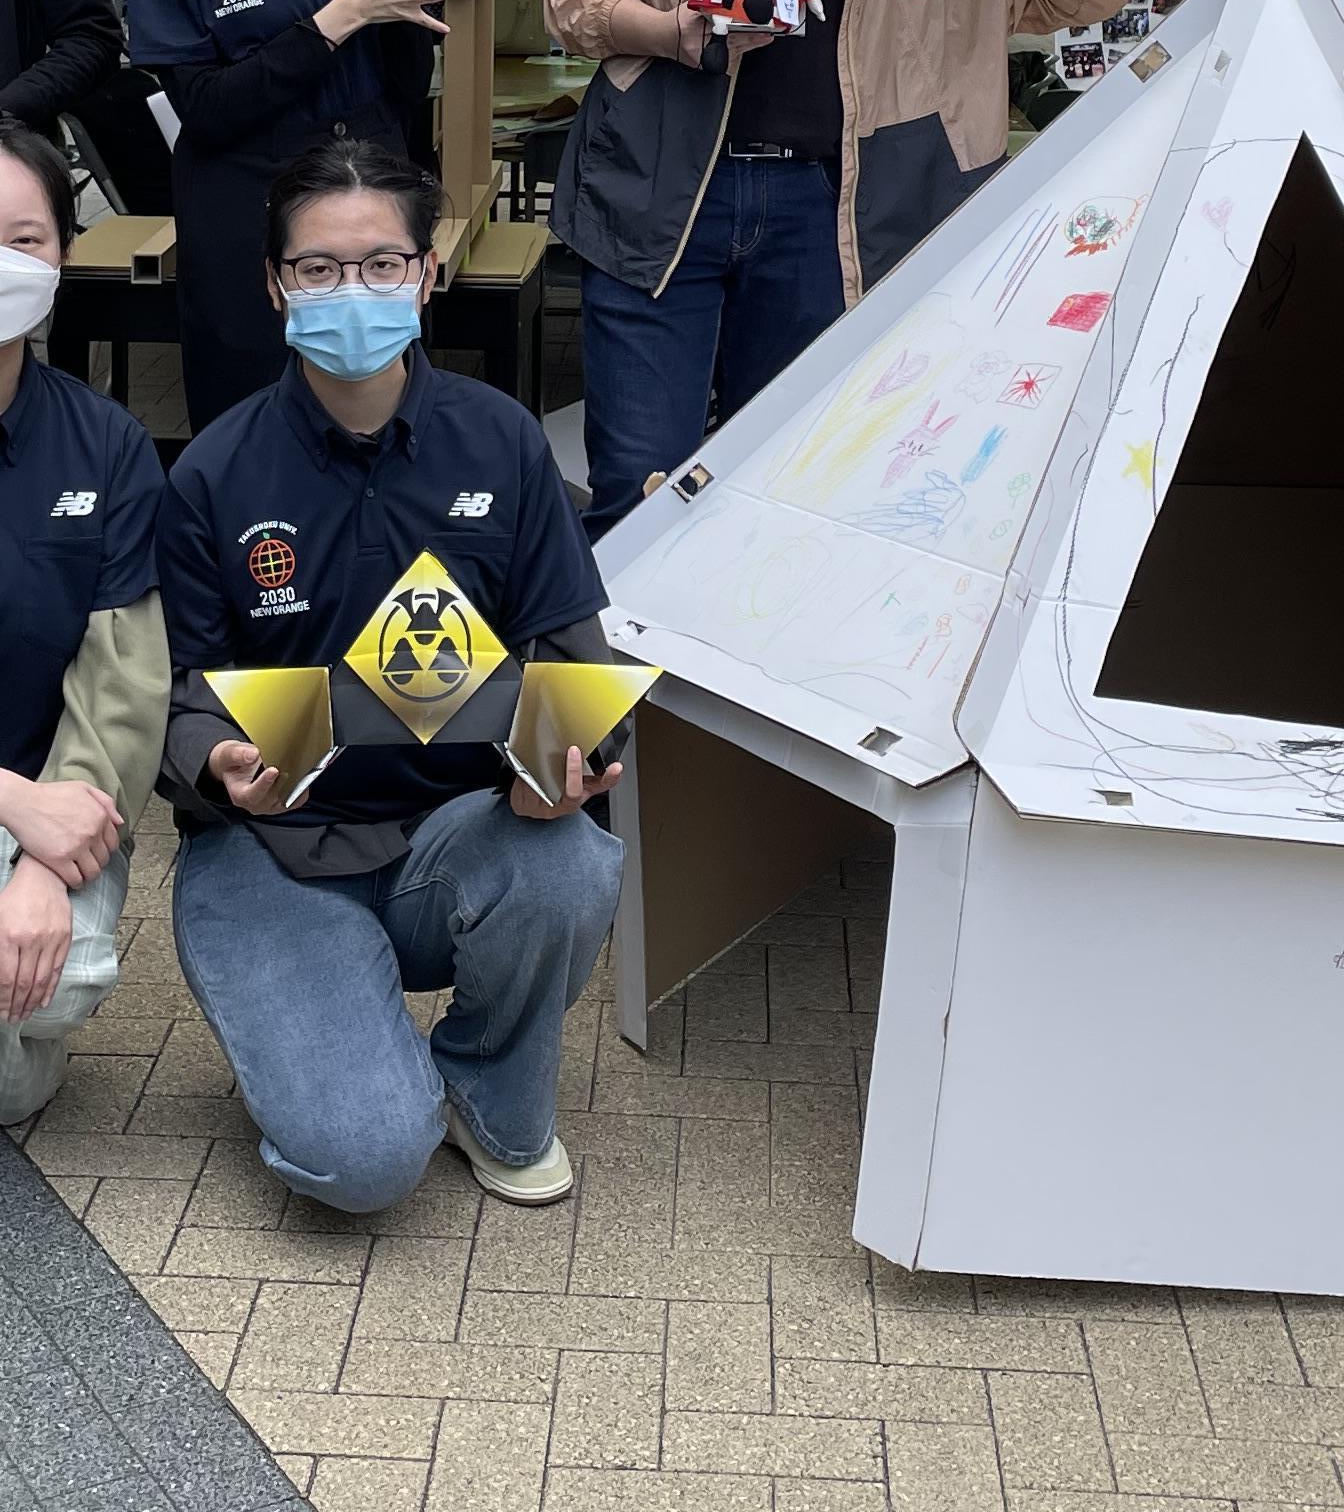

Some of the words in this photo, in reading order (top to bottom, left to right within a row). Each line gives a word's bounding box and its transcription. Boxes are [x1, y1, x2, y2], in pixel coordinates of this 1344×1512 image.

[259, 586, 296, 606] 2030
[249, 607, 273, 619] NEW
[272, 599, 311, 616] ORANGE
